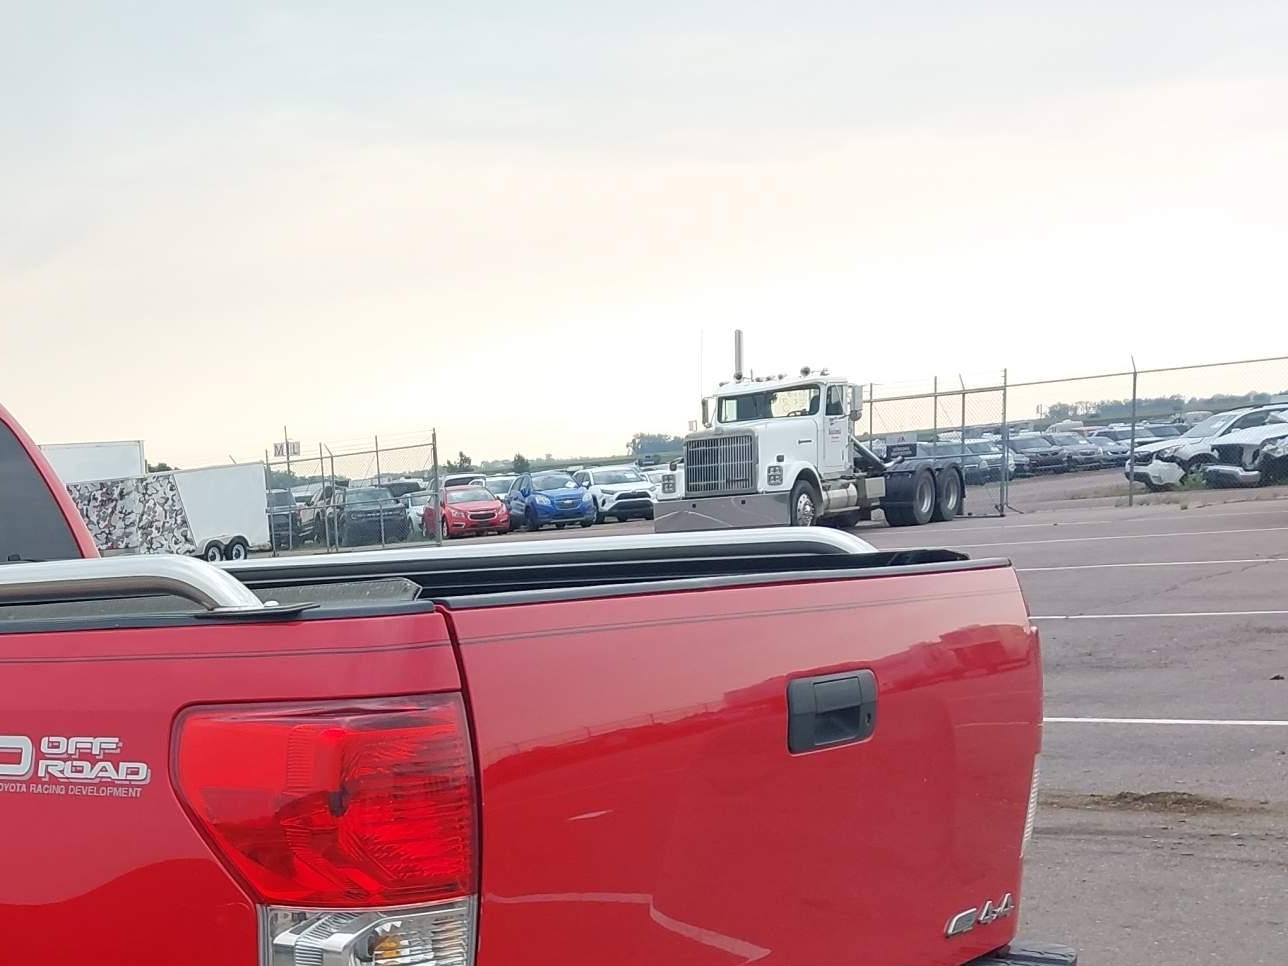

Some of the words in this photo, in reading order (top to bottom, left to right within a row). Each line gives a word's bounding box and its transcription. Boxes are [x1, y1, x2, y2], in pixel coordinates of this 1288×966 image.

[40, 736, 120, 756] OFF
[37, 759, 149, 782] ROAD
[29, 784, 66, 796] RACING
[68, 785, 143, 799] DEVELOPMENT
